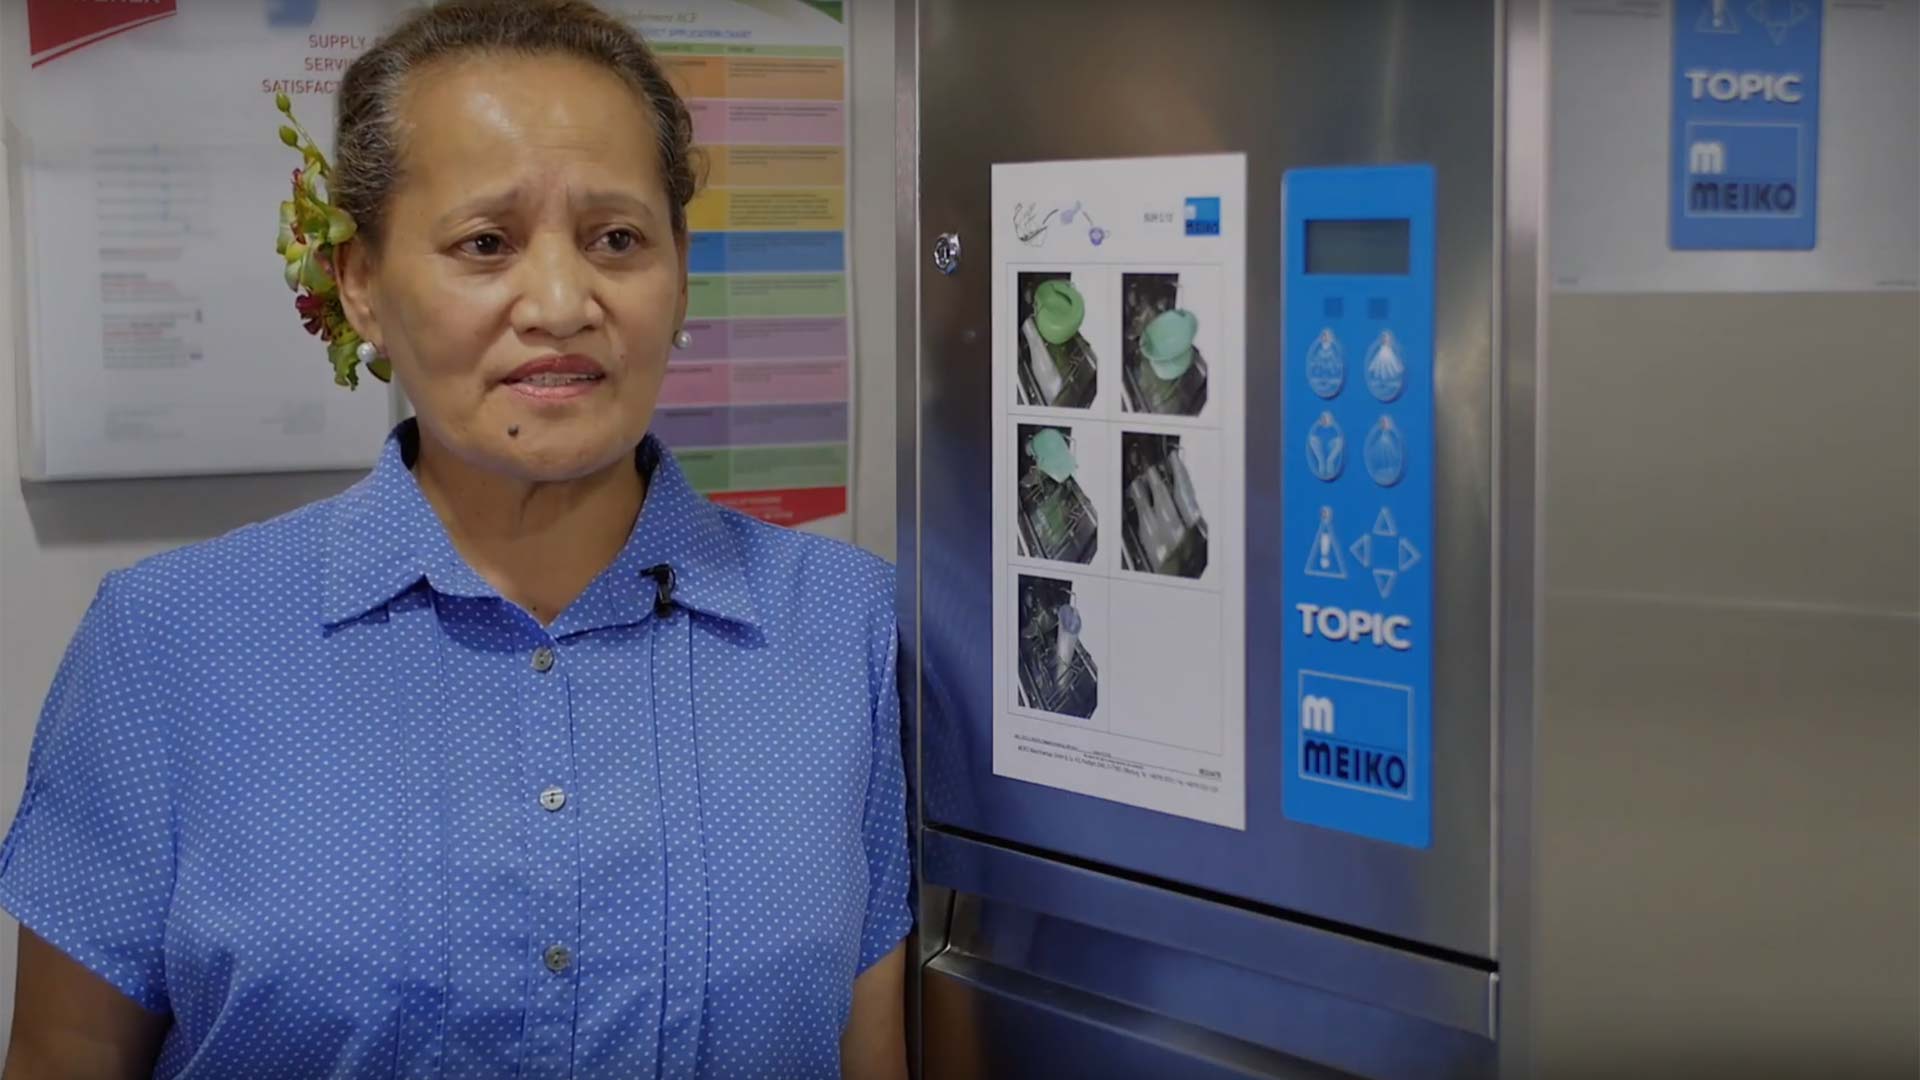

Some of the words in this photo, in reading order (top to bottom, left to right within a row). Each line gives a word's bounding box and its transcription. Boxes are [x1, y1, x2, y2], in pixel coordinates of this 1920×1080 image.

[308, 33, 367, 49] SUPPLY
[304, 57, 353, 72] SERVI
[1685, 70, 1804, 104] TOPIC
[1688, 182, 1797, 213] MEIKO
[1296, 602, 1412, 650] TOPIC
[1303, 739, 1407, 789] MEIKO
